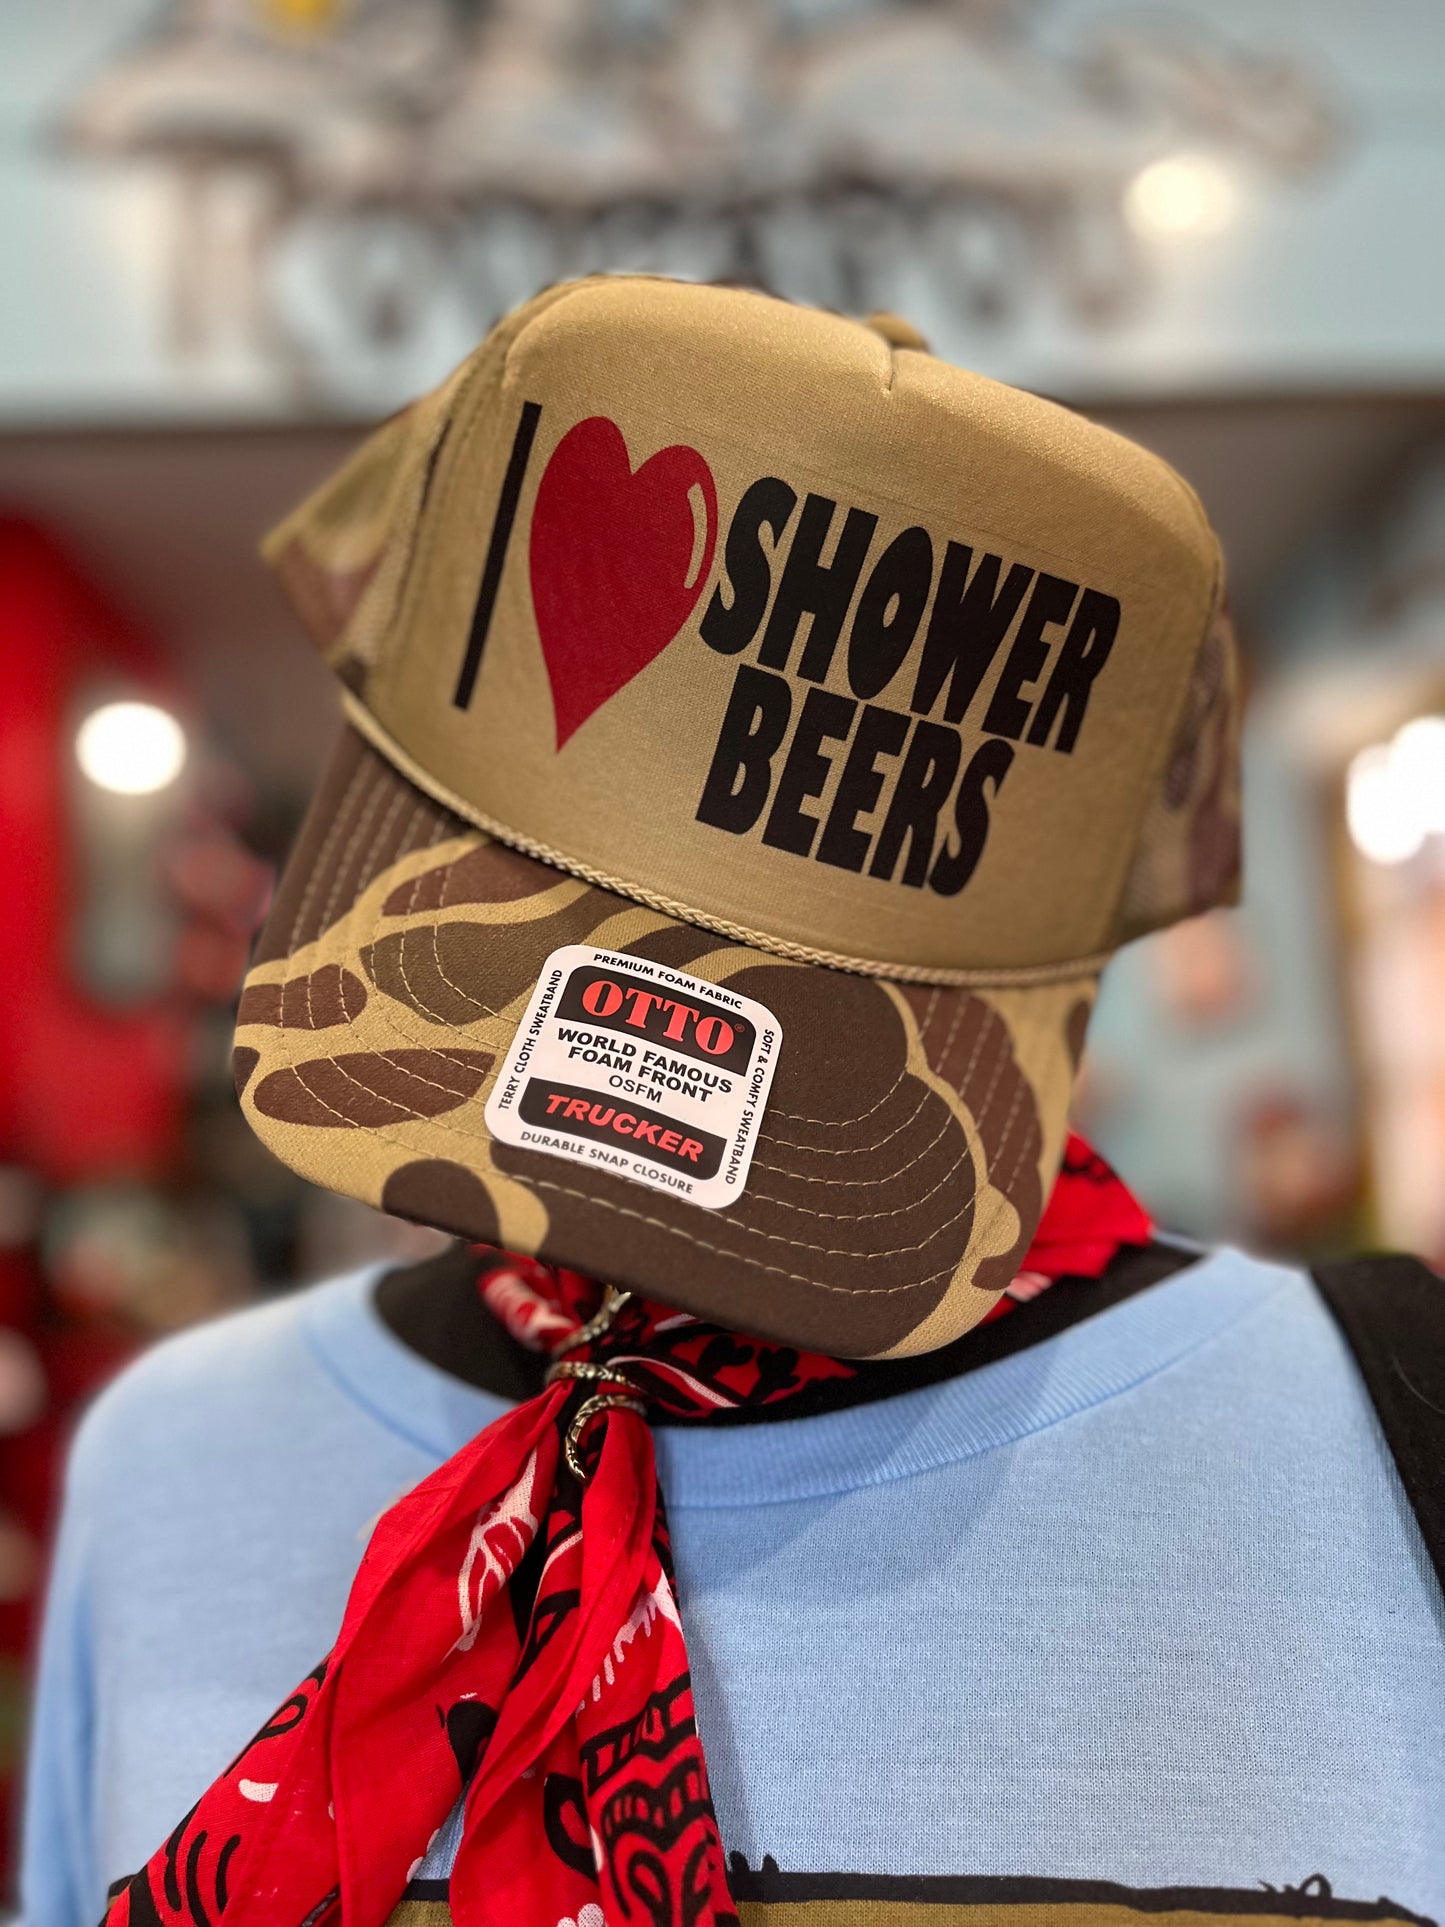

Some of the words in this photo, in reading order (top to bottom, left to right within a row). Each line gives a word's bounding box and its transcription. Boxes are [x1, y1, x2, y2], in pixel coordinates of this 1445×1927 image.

[453, 402, 543, 711] I
[699, 477, 1121, 754] SHOWER
[695, 663, 1015, 896] BEERS
[594, 954, 654, 976] PREMIUM
[658, 971, 696, 991] FOAM
[699, 986, 742, 1009] FABRIC
[498, 1076, 520, 1110] TERRY
[514, 1037, 535, 1073] CLOTH
[532, 969, 562, 1036] SWEATBAND
[558, 1027, 637, 1056] WORLD
[643, 1052, 732, 1093] FAMOUS
[757, 1029, 774, 1054] SOFT
[568, 1047, 632, 1073] FOAM
[639, 1067, 712, 1102] FRONT
[608, 1075, 663, 1103] OSFM
[747, 1066, 765, 1108] COMFY
[546, 1094, 704, 1162] TRUCKER
[725, 1110, 754, 1185] SWEATBAND
[521, 1131, 584, 1154] DURABLE
[589, 1148, 628, 1168] SNAP
[633, 1163, 693, 1194] CLOSURE
